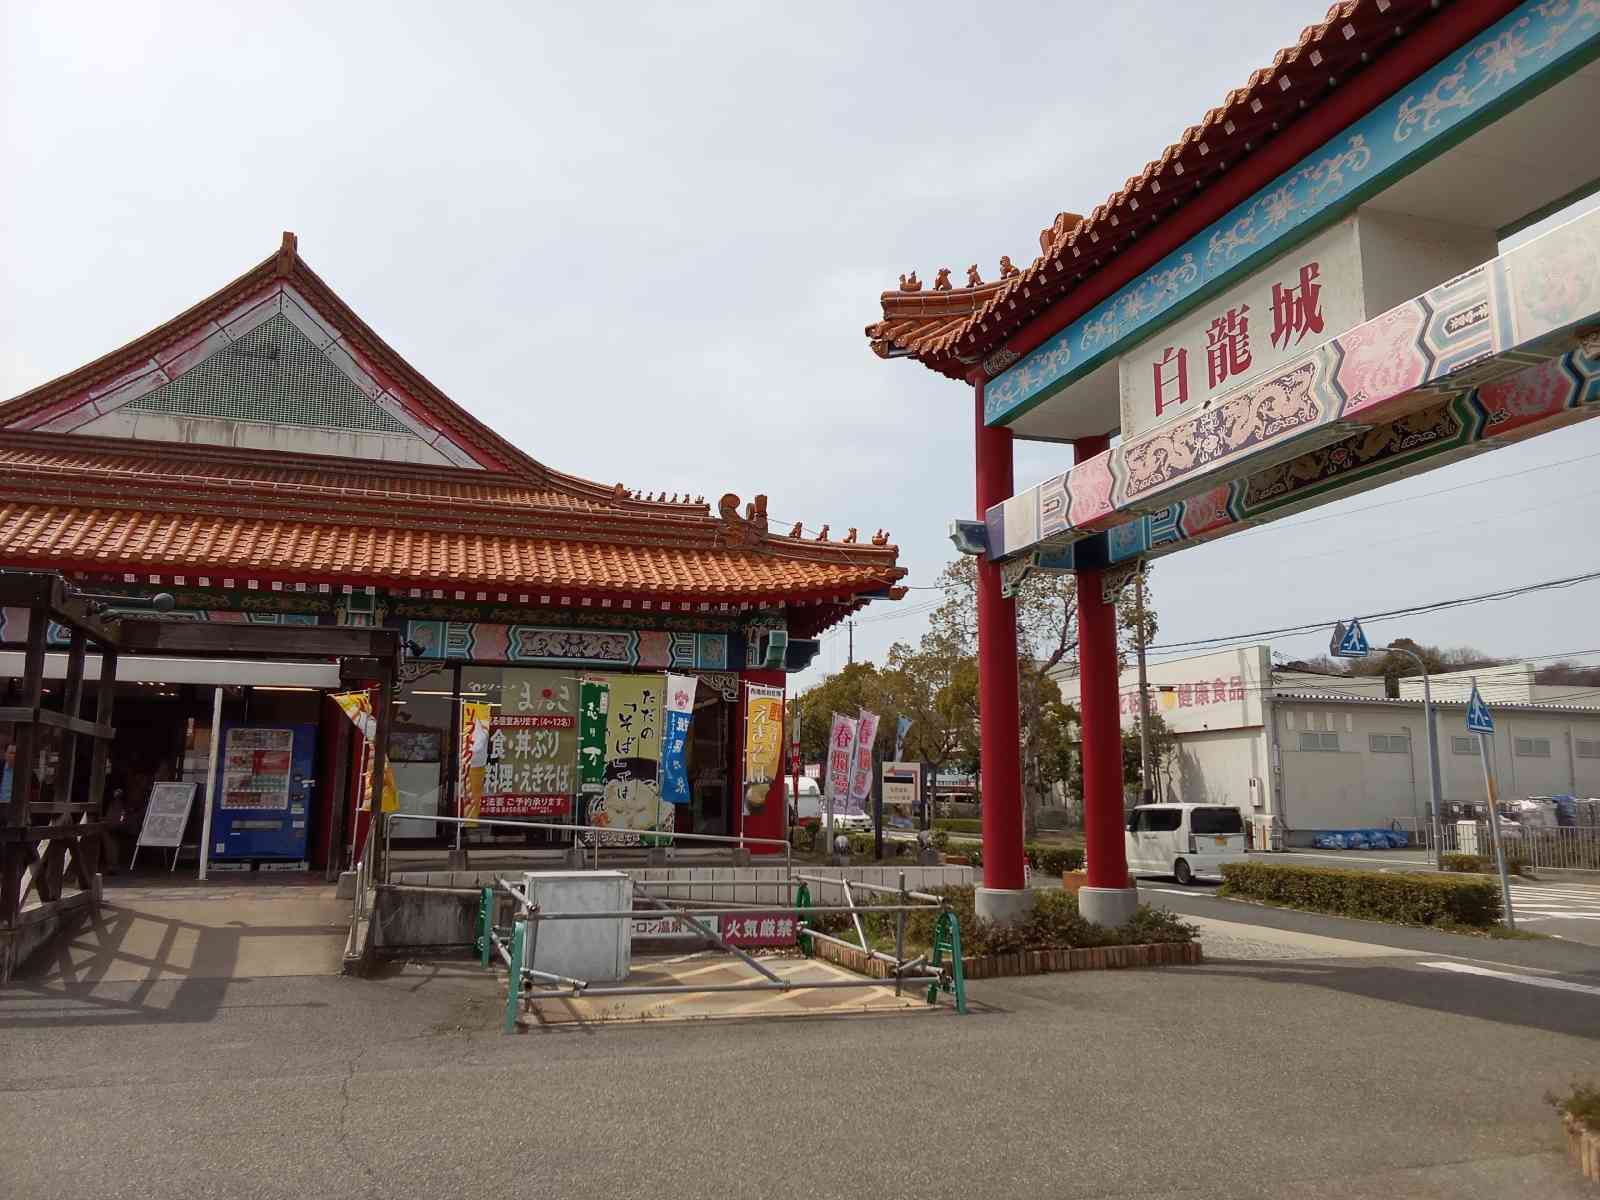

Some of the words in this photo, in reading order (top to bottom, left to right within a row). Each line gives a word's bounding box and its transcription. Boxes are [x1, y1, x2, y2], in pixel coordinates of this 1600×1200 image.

[1153, 262, 1324, 416] 白龍城
[1178, 675, 1246, 708] 健康食品
[640, 689, 655, 740] ただの
[726, 919, 793, 938] 火気厳禁
